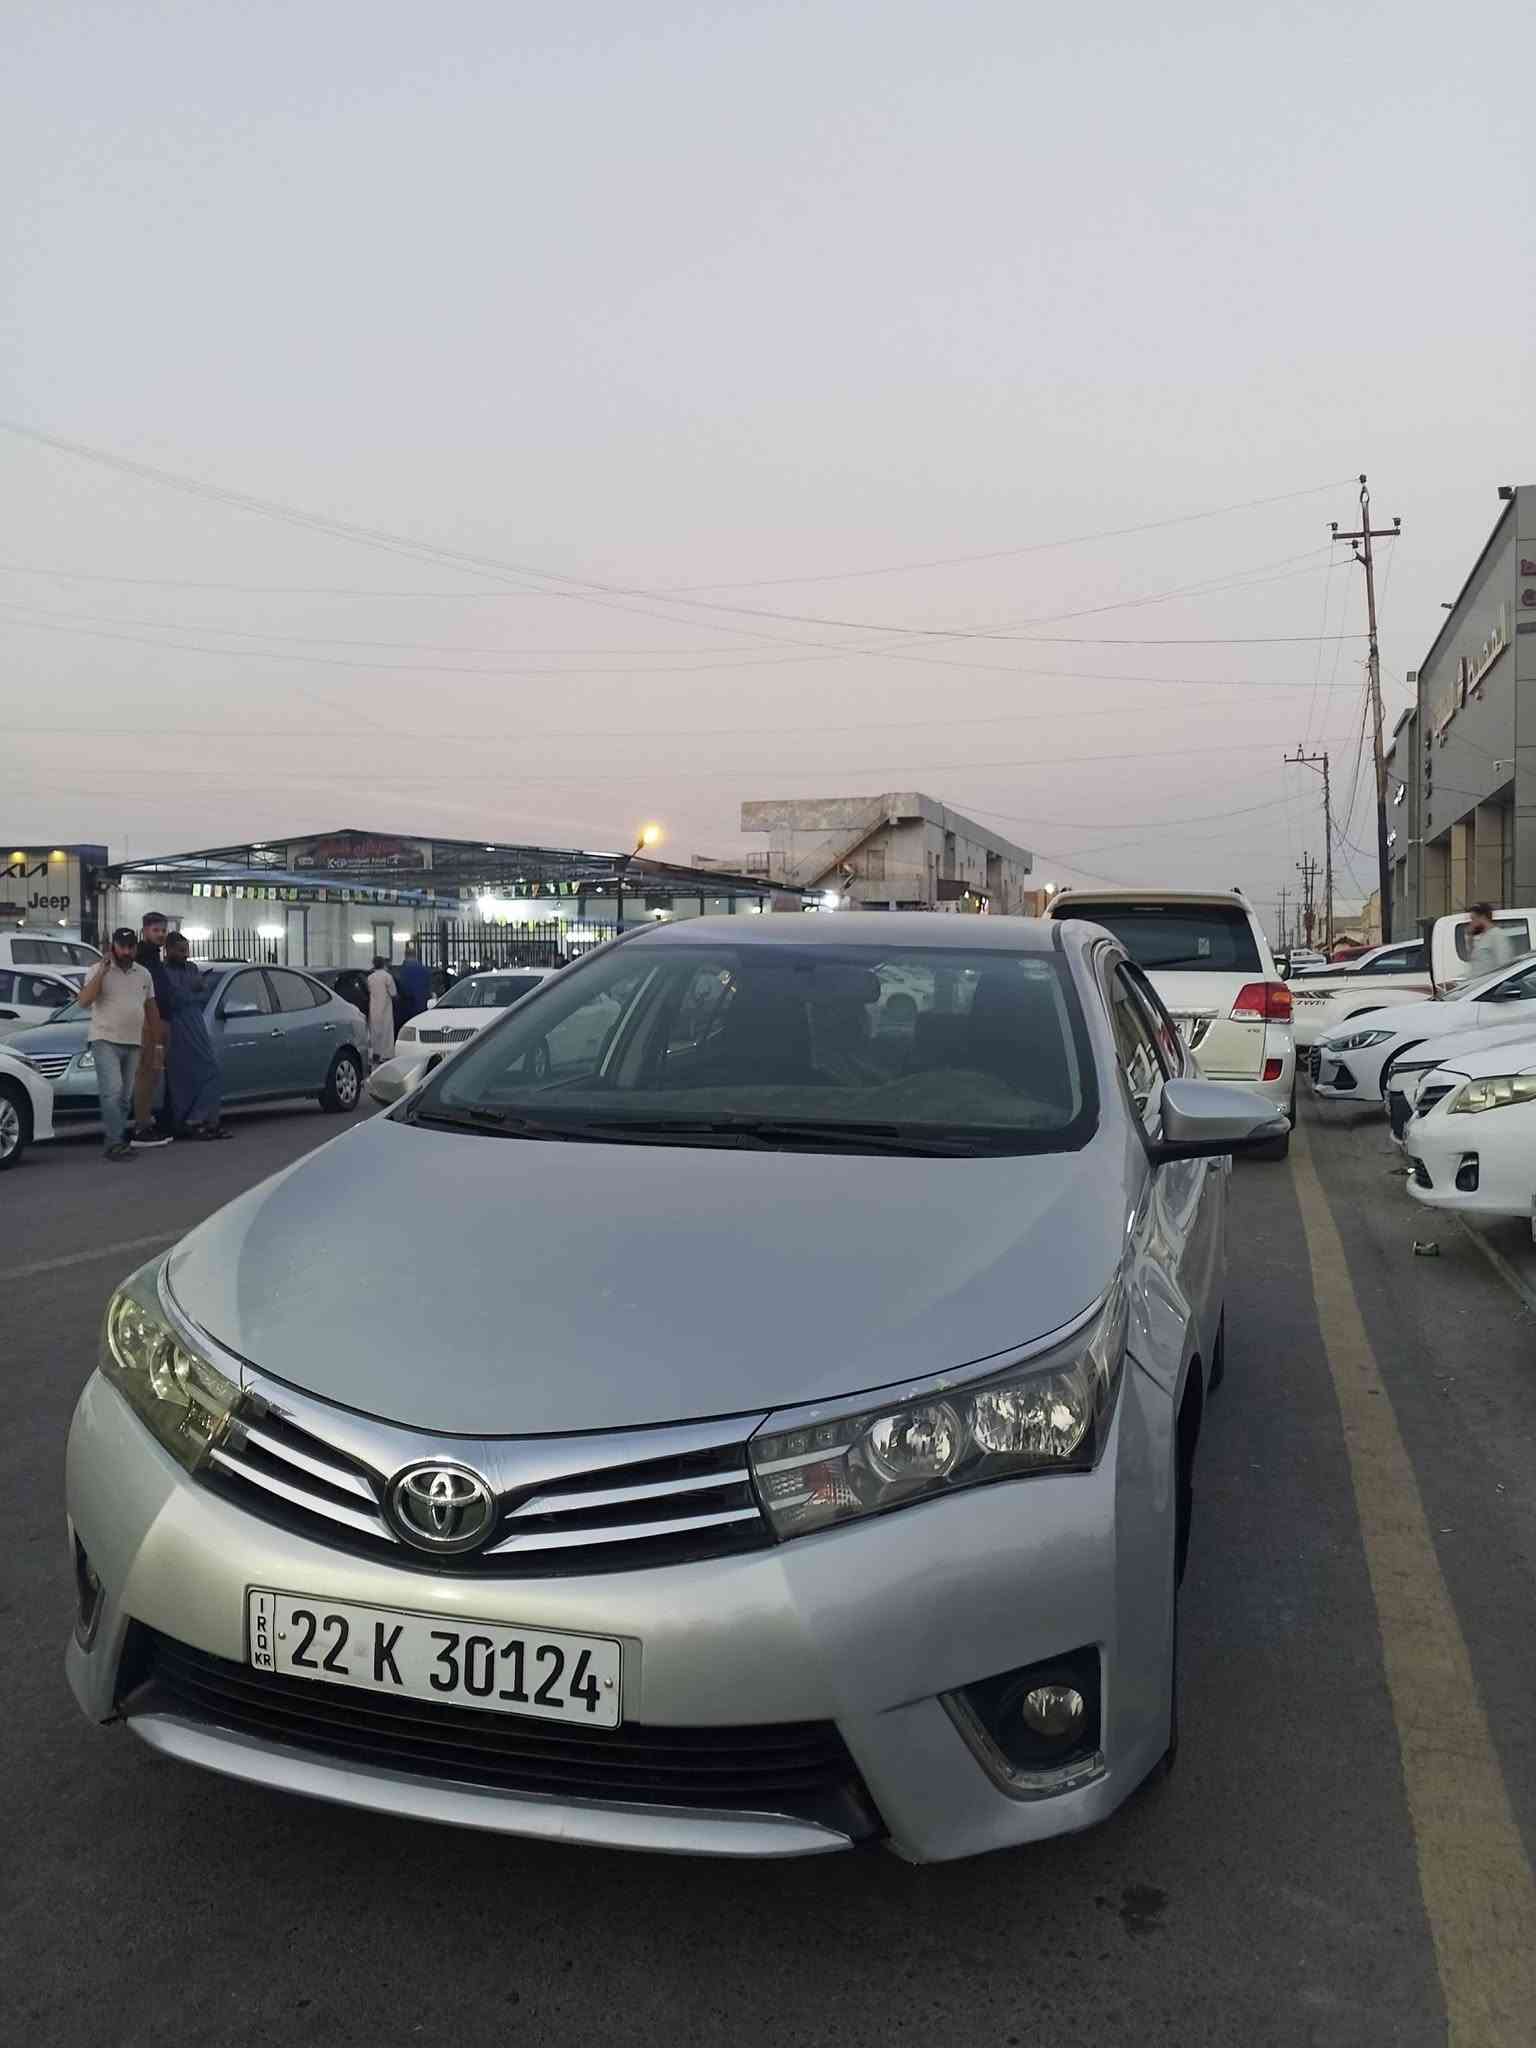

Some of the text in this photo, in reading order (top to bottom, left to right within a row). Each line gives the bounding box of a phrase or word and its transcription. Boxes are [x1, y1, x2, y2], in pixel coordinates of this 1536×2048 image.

[27, 892, 71, 911] Jeep
[255, 1652, 271, 1666] KR
[291, 1610, 601, 1713] 22 K 30124
